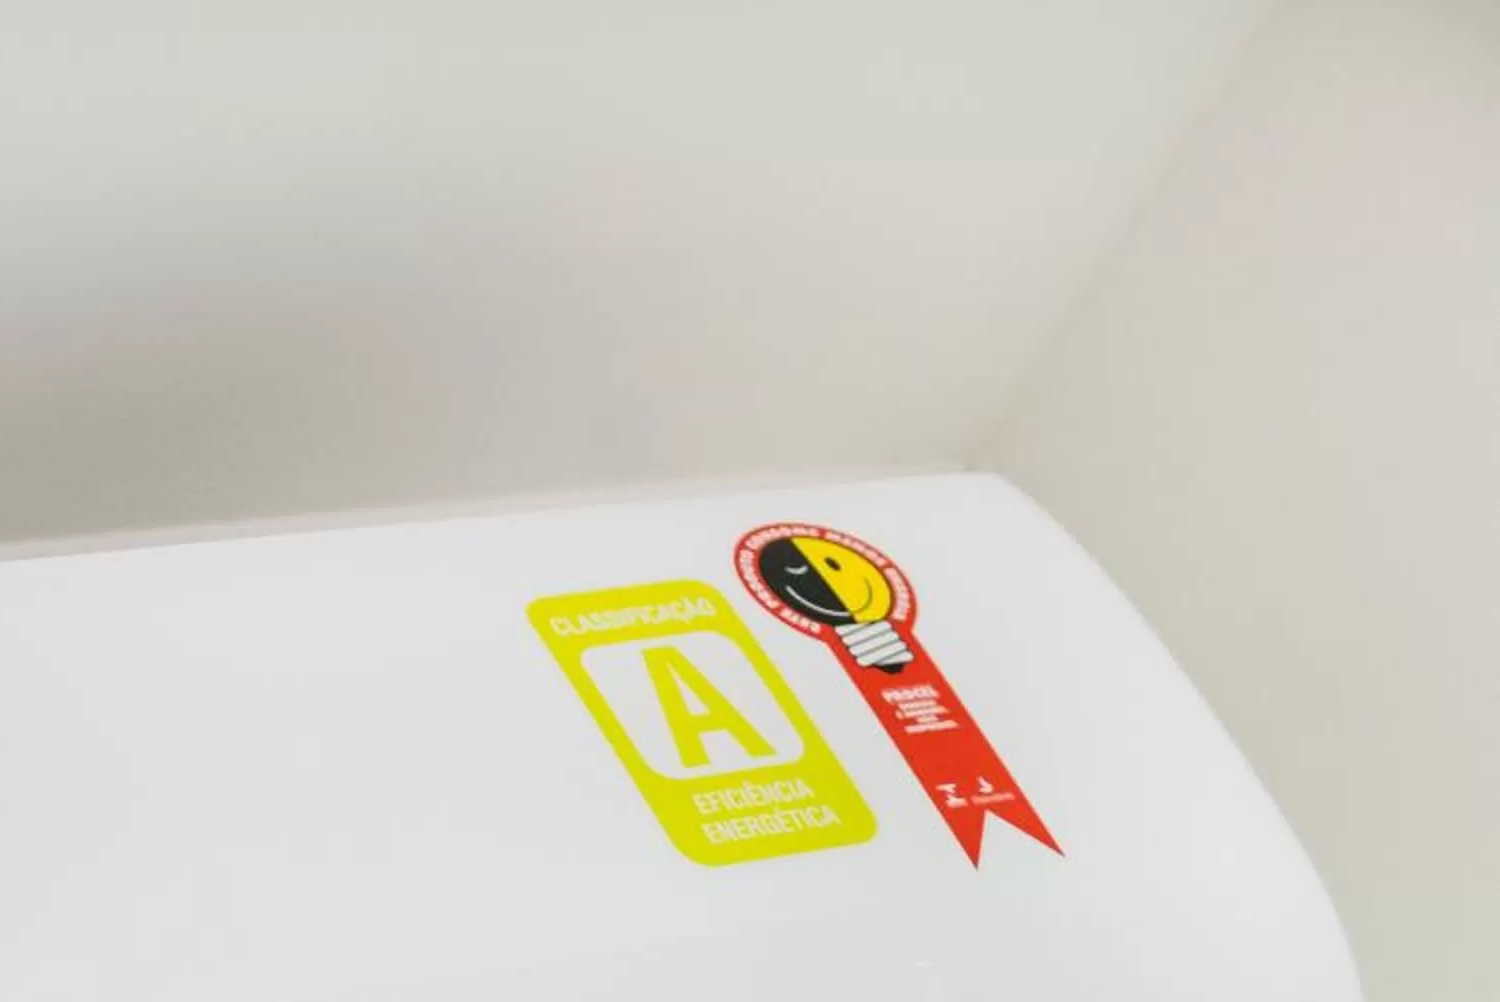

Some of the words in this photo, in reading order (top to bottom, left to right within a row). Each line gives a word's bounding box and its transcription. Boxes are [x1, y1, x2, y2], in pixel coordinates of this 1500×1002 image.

[548, 596, 718, 637] CLASSIFICAÇÃO
[640, 646, 777, 769] A
[691, 777, 816, 815] EFICIÊNCIA
[701, 803, 842, 844] ENERGÉTICA
